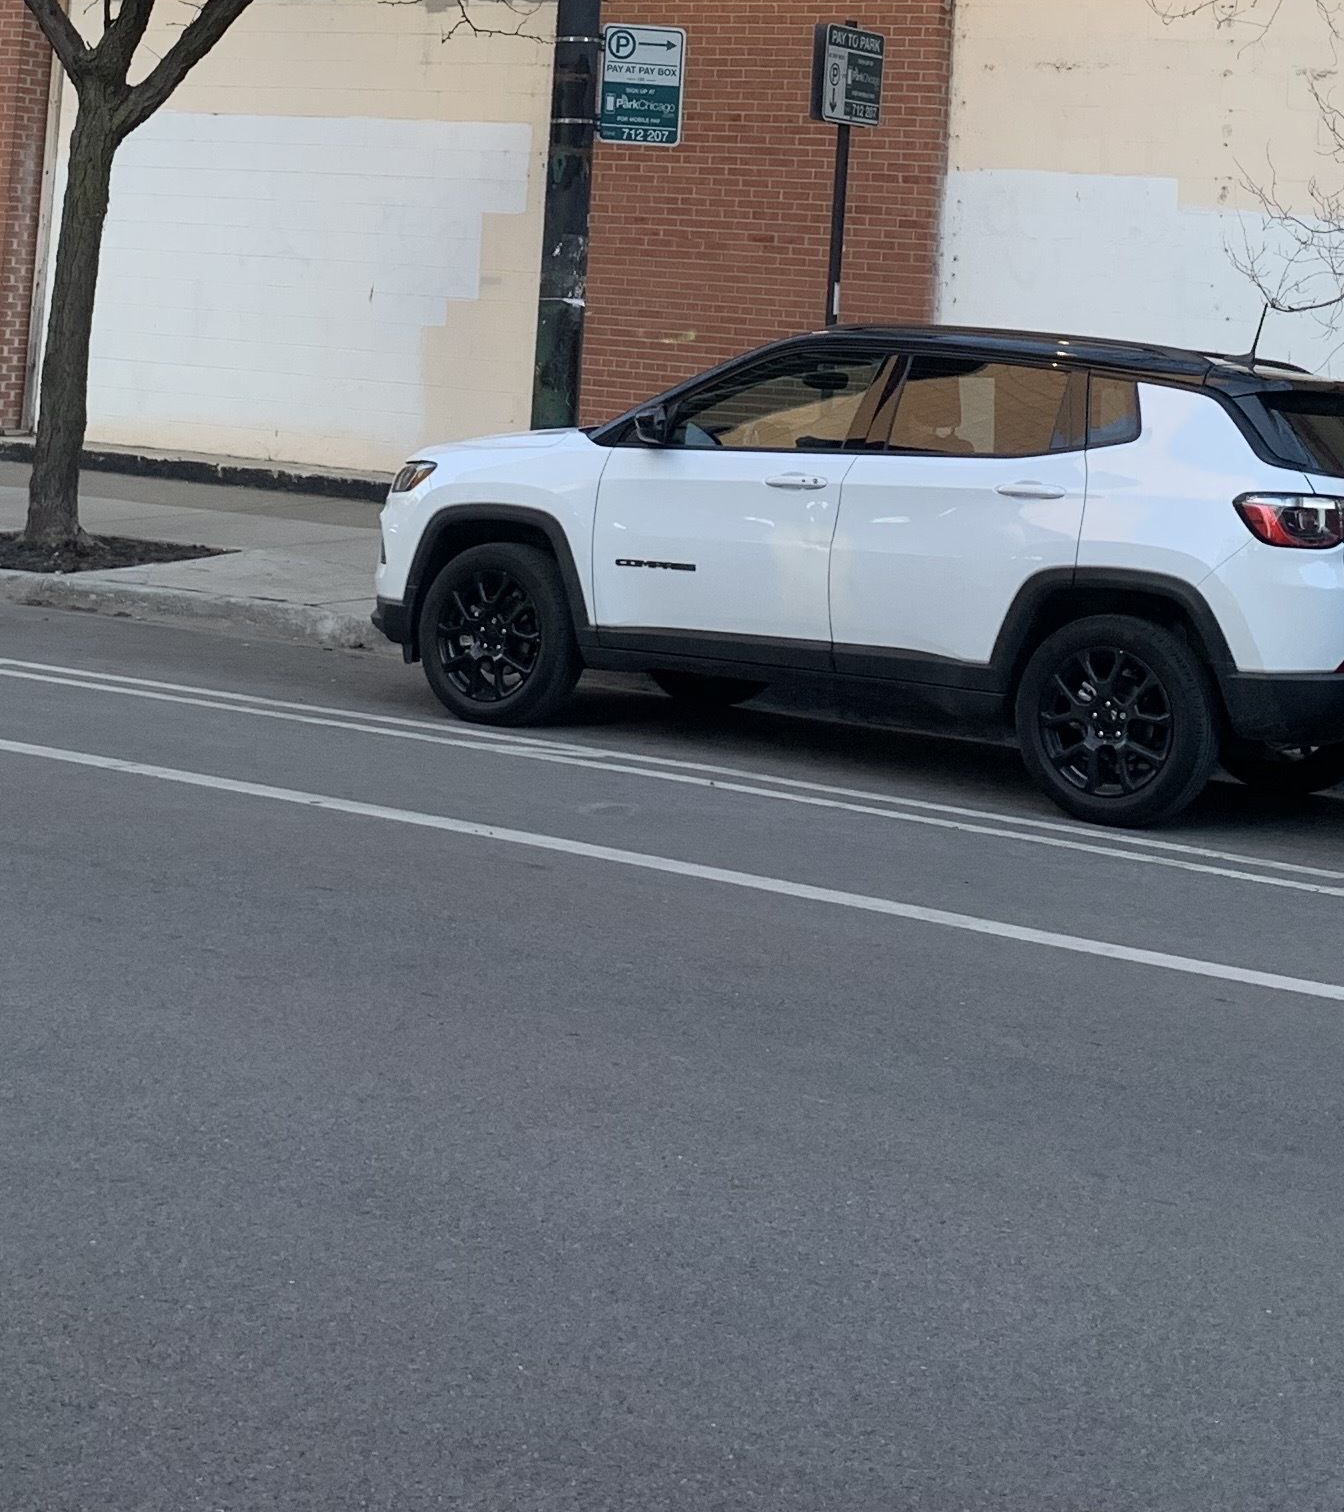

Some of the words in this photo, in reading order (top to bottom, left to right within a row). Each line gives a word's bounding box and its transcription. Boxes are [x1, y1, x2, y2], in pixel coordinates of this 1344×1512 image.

[831, 30, 846, 44] PAY
[848, 33, 859, 48] TO
[859, 36, 881, 52] PARK
[606, 63, 624, 73] PAY
[625, 64, 636, 74] AT
[638, 66, 656, 75] PAY
[658, 68, 677, 77] BOX
[852, 104, 864, 117] 712
[865, 105, 877, 119] 207
[622, 129, 644, 140] 712
[647, 130, 669, 142] 207
